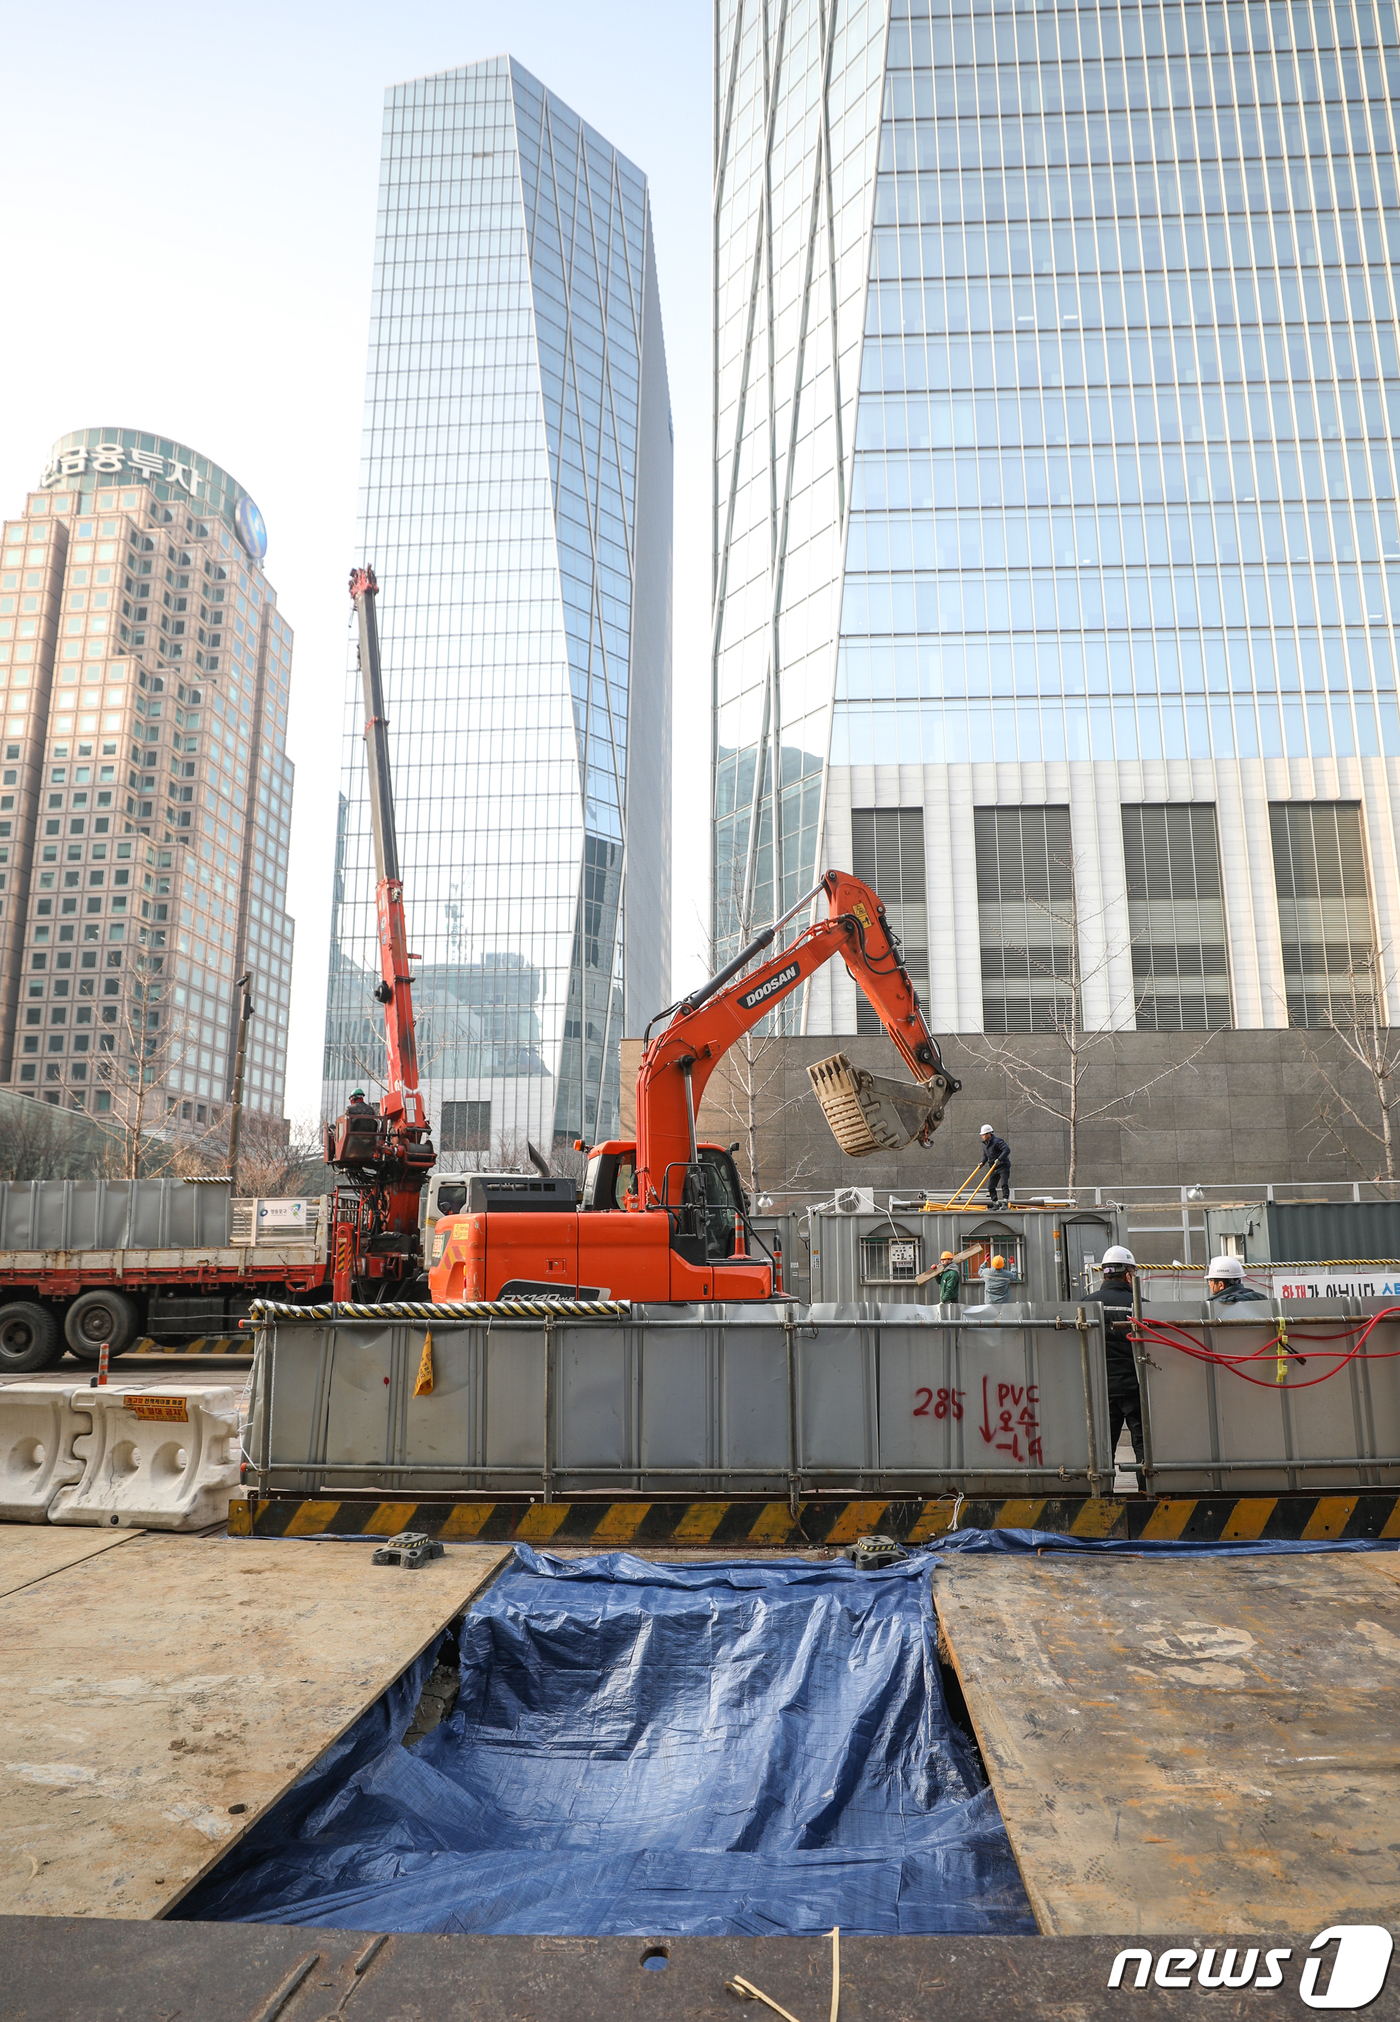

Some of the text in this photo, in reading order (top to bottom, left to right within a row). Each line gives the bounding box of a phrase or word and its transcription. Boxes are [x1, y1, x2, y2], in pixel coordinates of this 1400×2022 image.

[745, 966, 797, 1007] DOOSAN
[913, 1387, 966, 1420] 285
[997, 1382, 1040, 1408] PVC
[999, 1406, 1040, 1438] 오수
